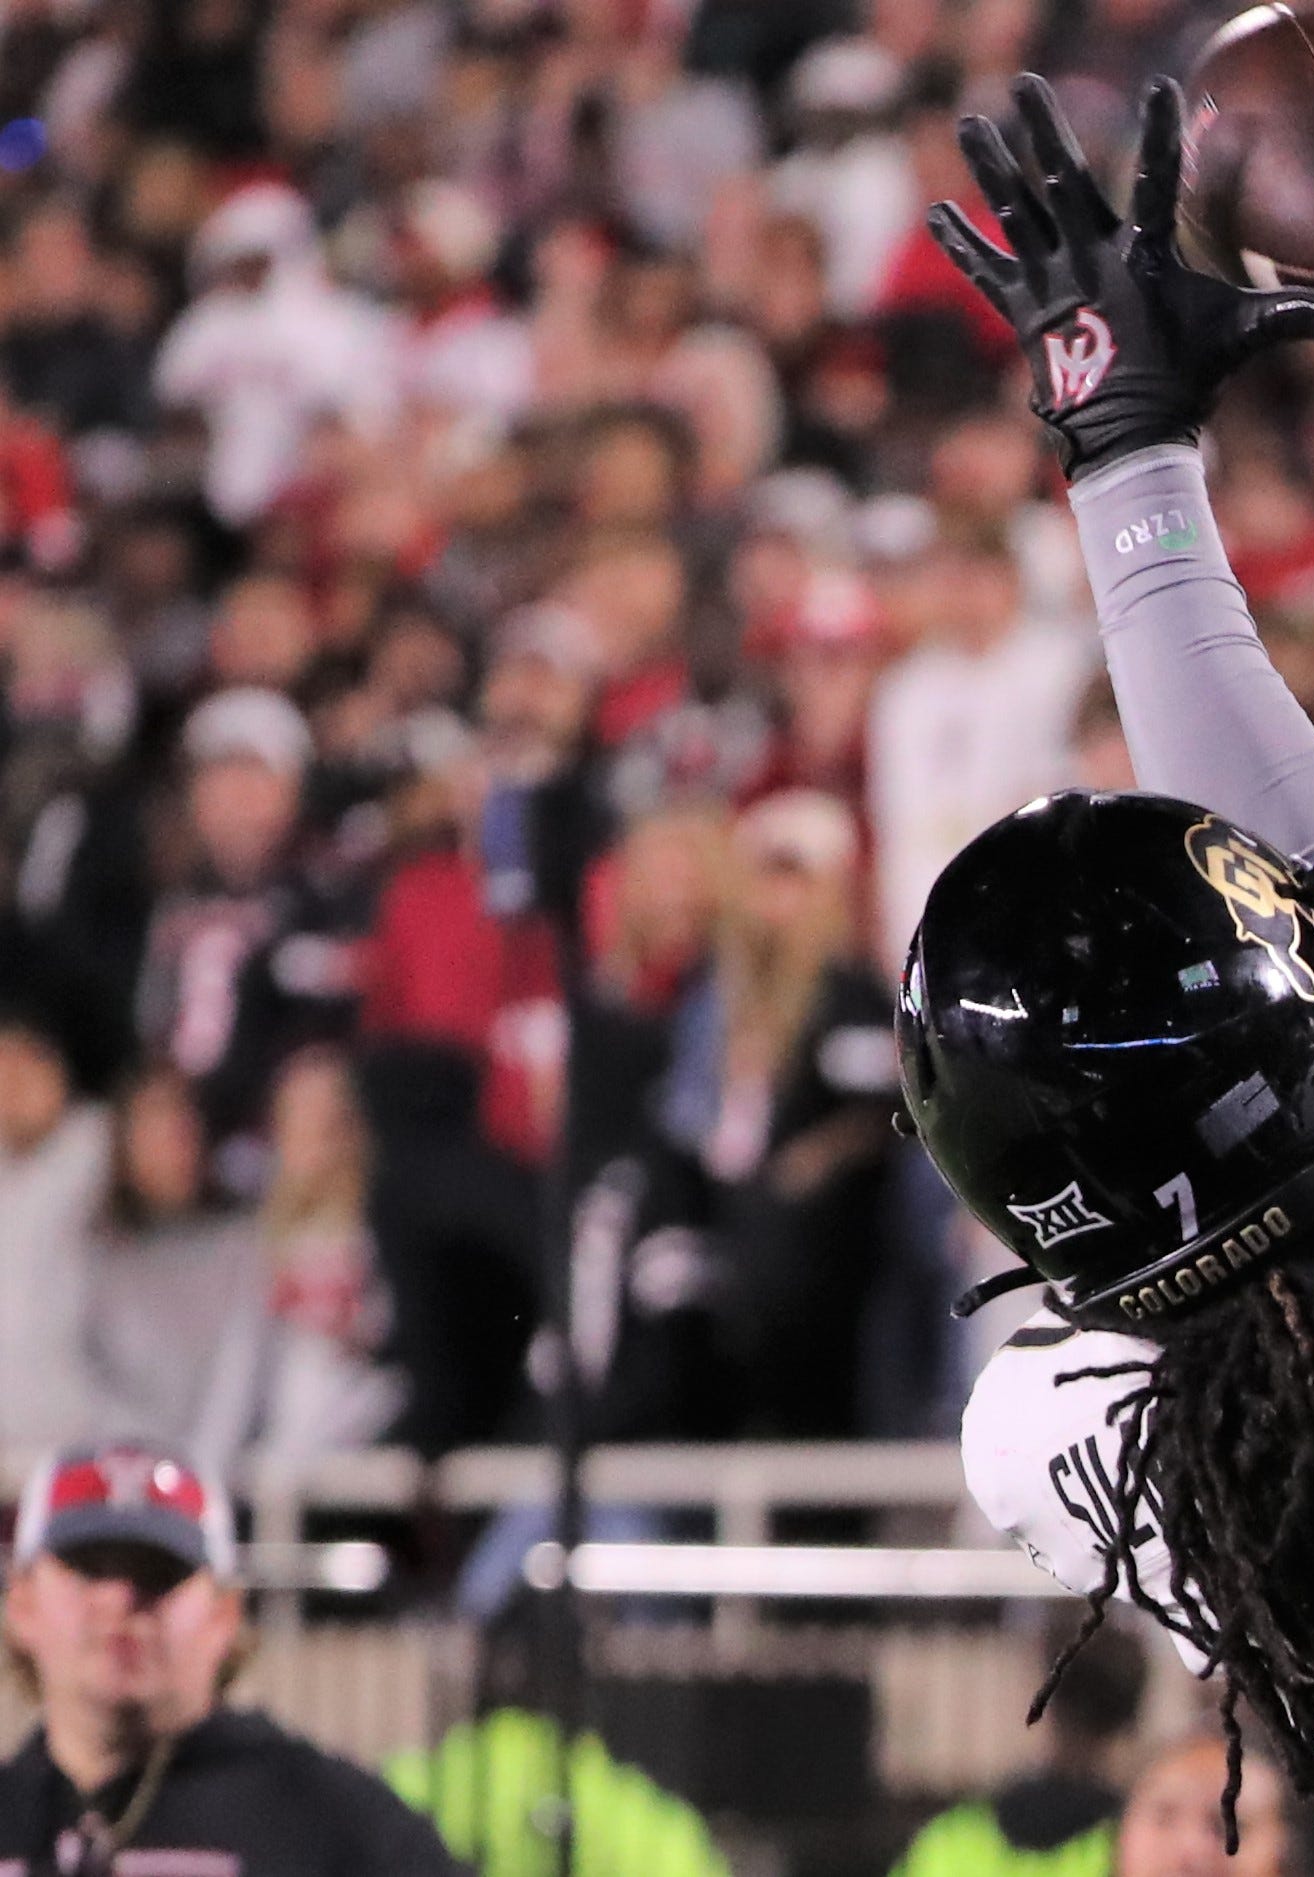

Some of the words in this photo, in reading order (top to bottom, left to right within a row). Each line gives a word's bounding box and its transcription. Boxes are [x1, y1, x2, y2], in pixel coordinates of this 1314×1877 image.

[1115, 509, 1186, 554] LZRD
[1153, 1171, 1199, 1241] 7
[1119, 1206, 1291, 1320] COLORADO
